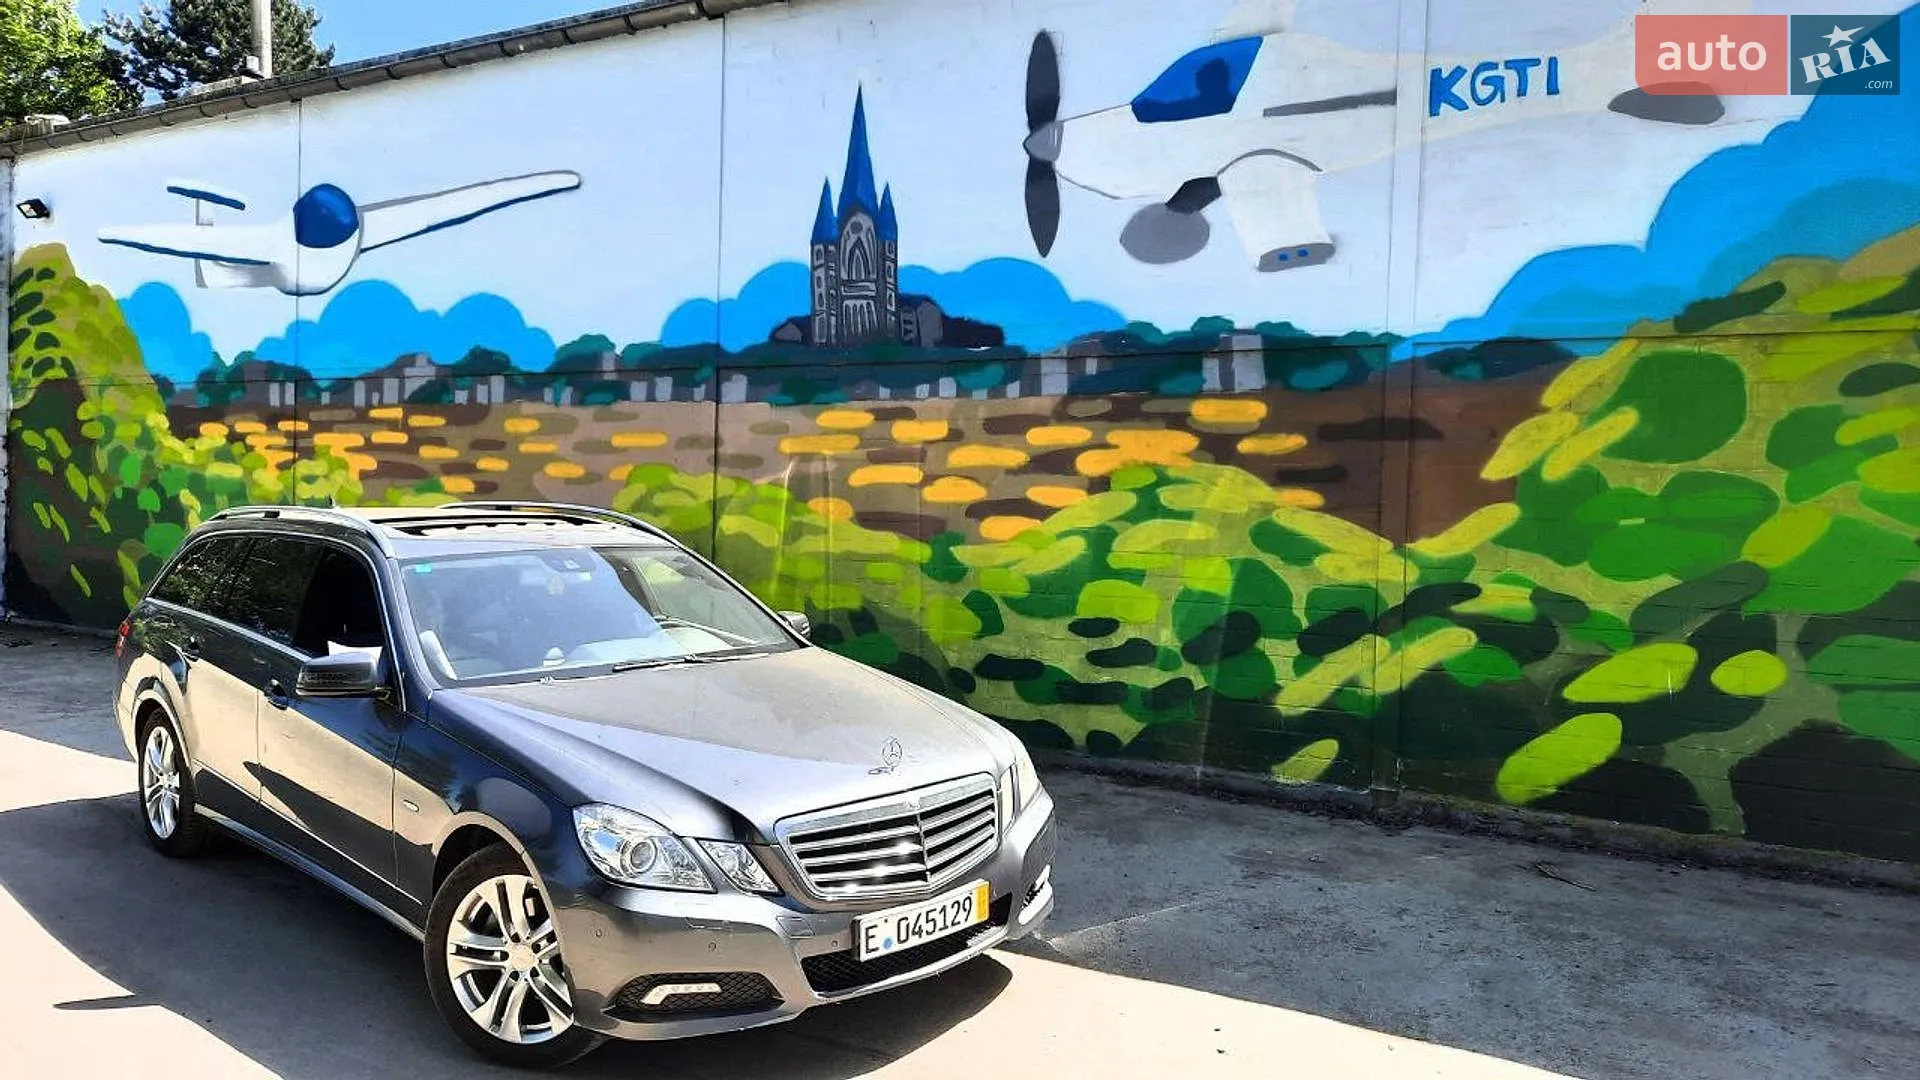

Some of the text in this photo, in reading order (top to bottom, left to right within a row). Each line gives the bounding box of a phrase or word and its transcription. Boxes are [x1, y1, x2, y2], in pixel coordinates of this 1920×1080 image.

[1429, 56, 1560, 117] KGTI
[865, 924, 880, 954] E
[897, 896, 973, 944] 045129
